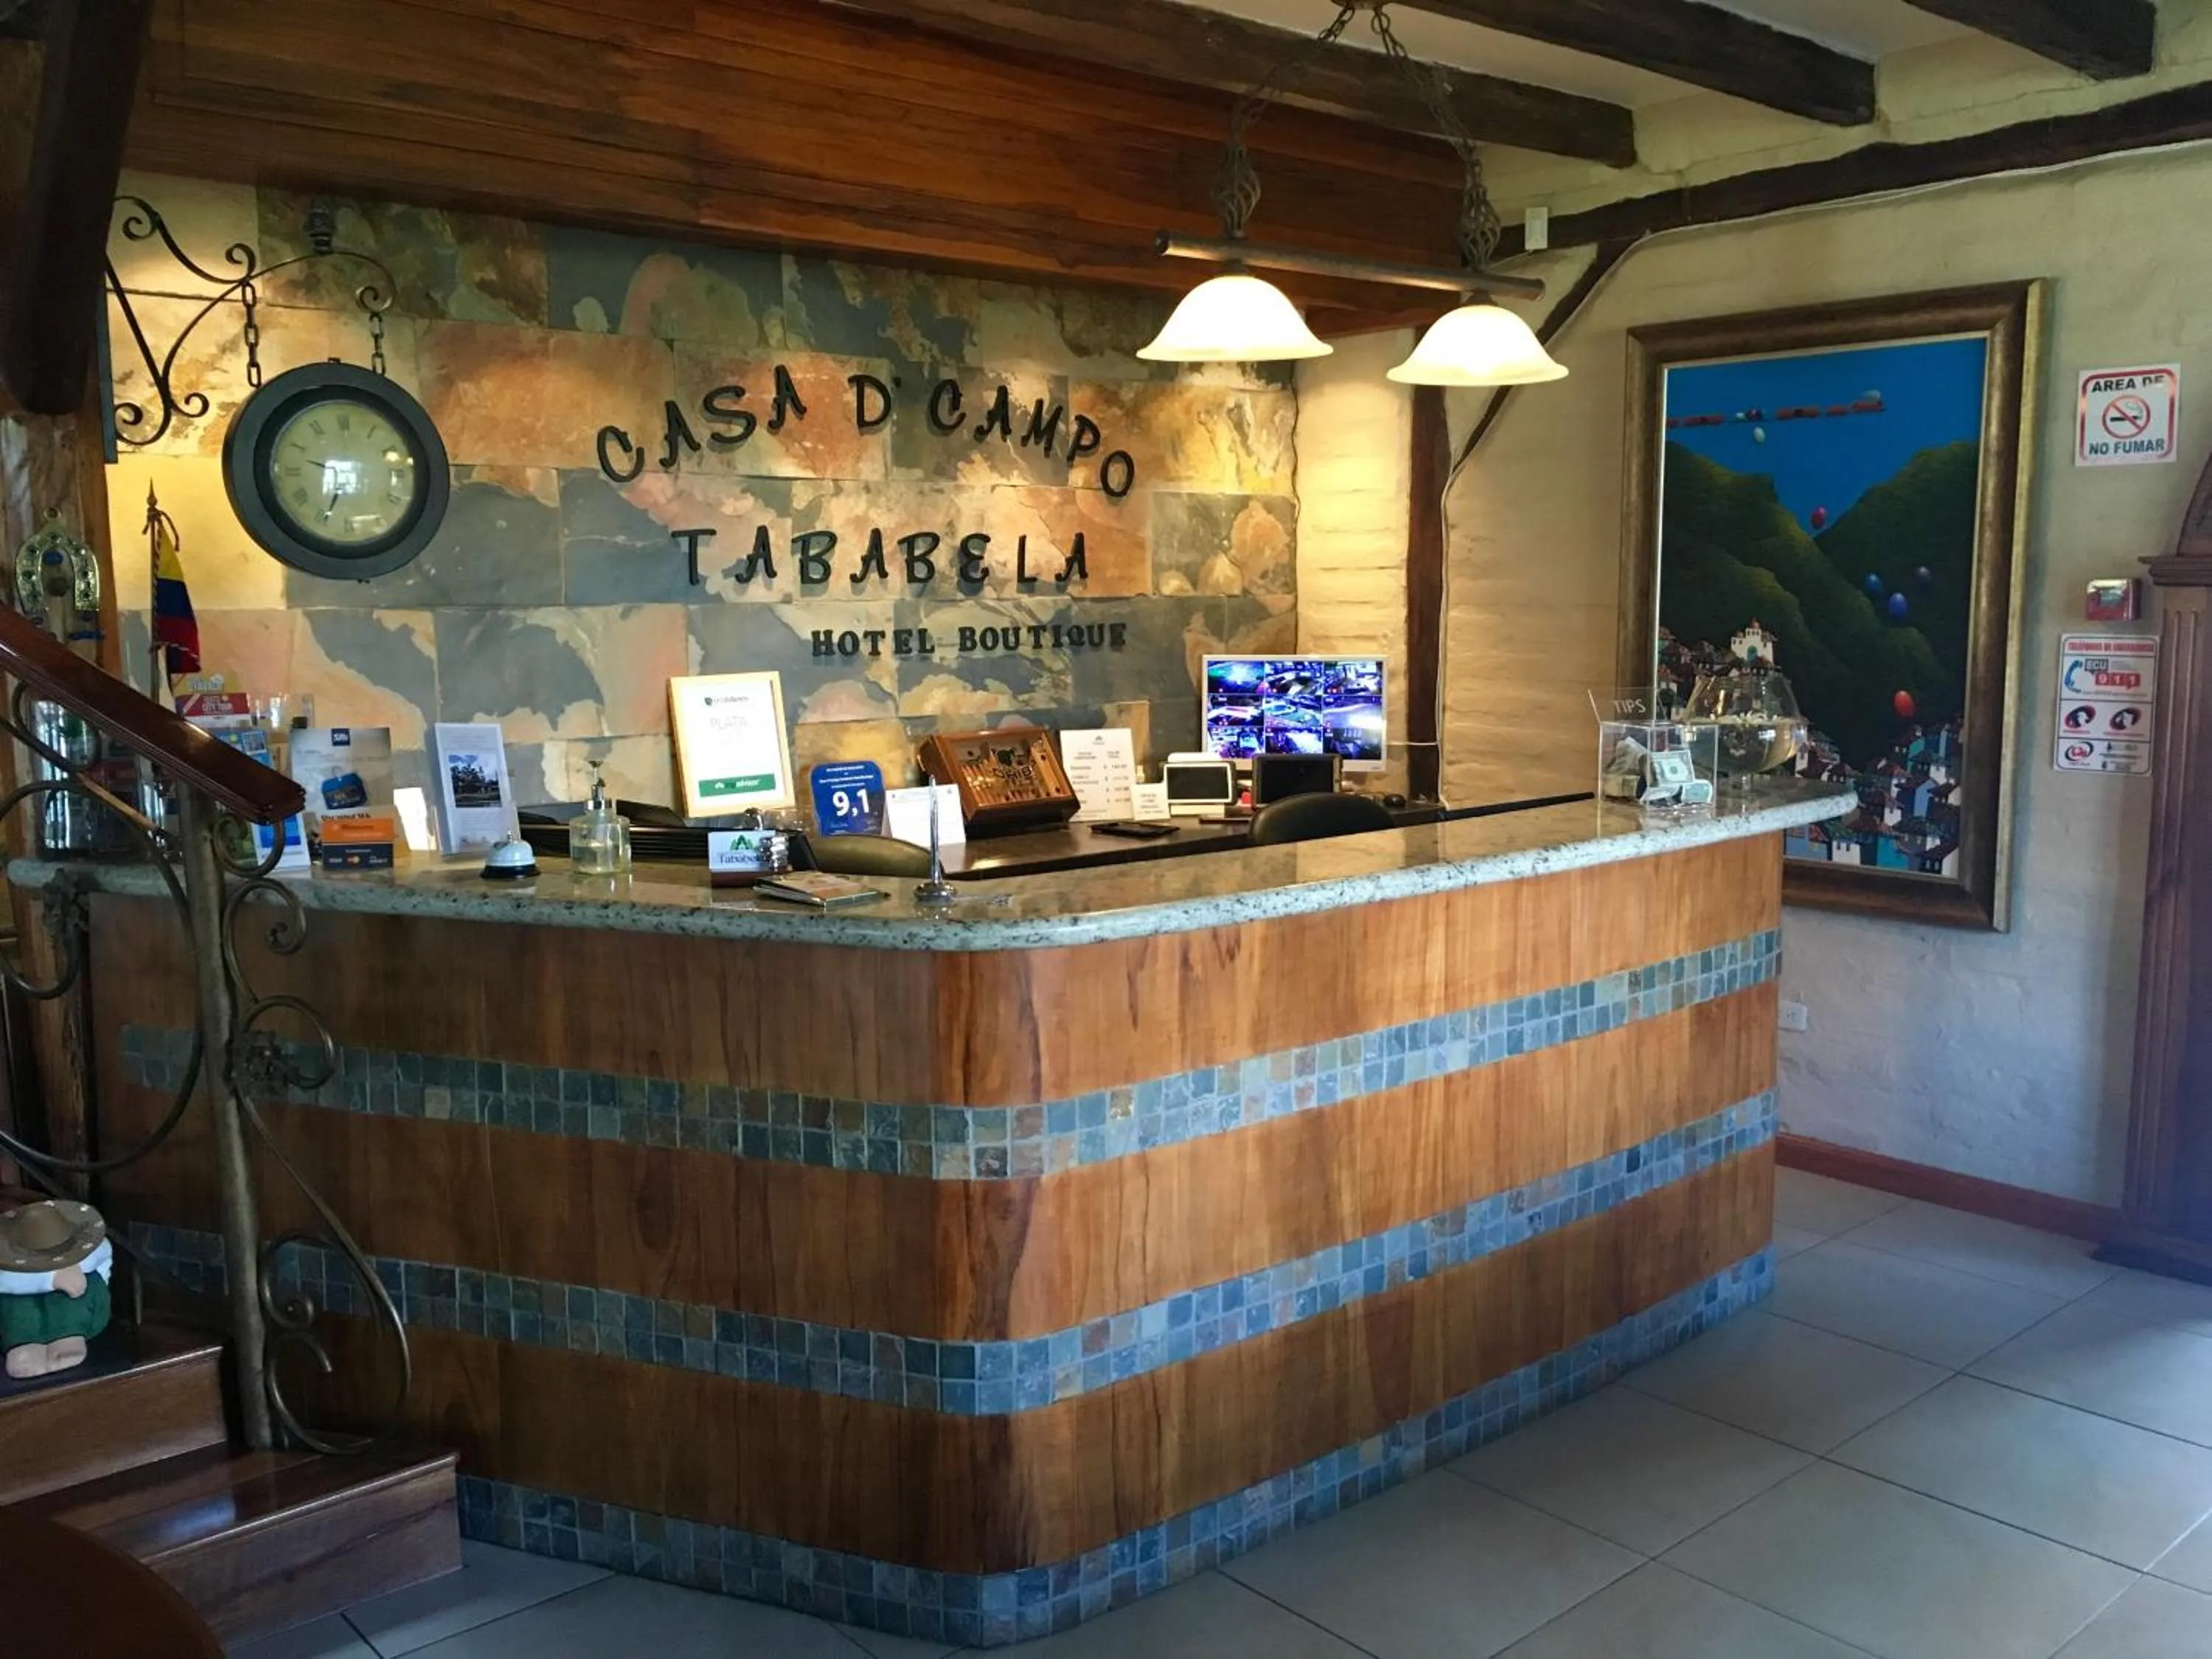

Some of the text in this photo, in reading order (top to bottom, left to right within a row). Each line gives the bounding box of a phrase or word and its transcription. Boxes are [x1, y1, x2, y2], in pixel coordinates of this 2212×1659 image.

[2092, 378, 2136, 392] AREA
[597, 364, 807, 482] CASA
[2089, 438, 2165, 455] NO FUMAR
[671, 525, 1088, 586] TABABELA
[812, 622, 1126, 657] HOTEL BOUTIQUE
[1613, 698, 1646, 714] TIPS
[832, 788, 870, 817] 9,1
